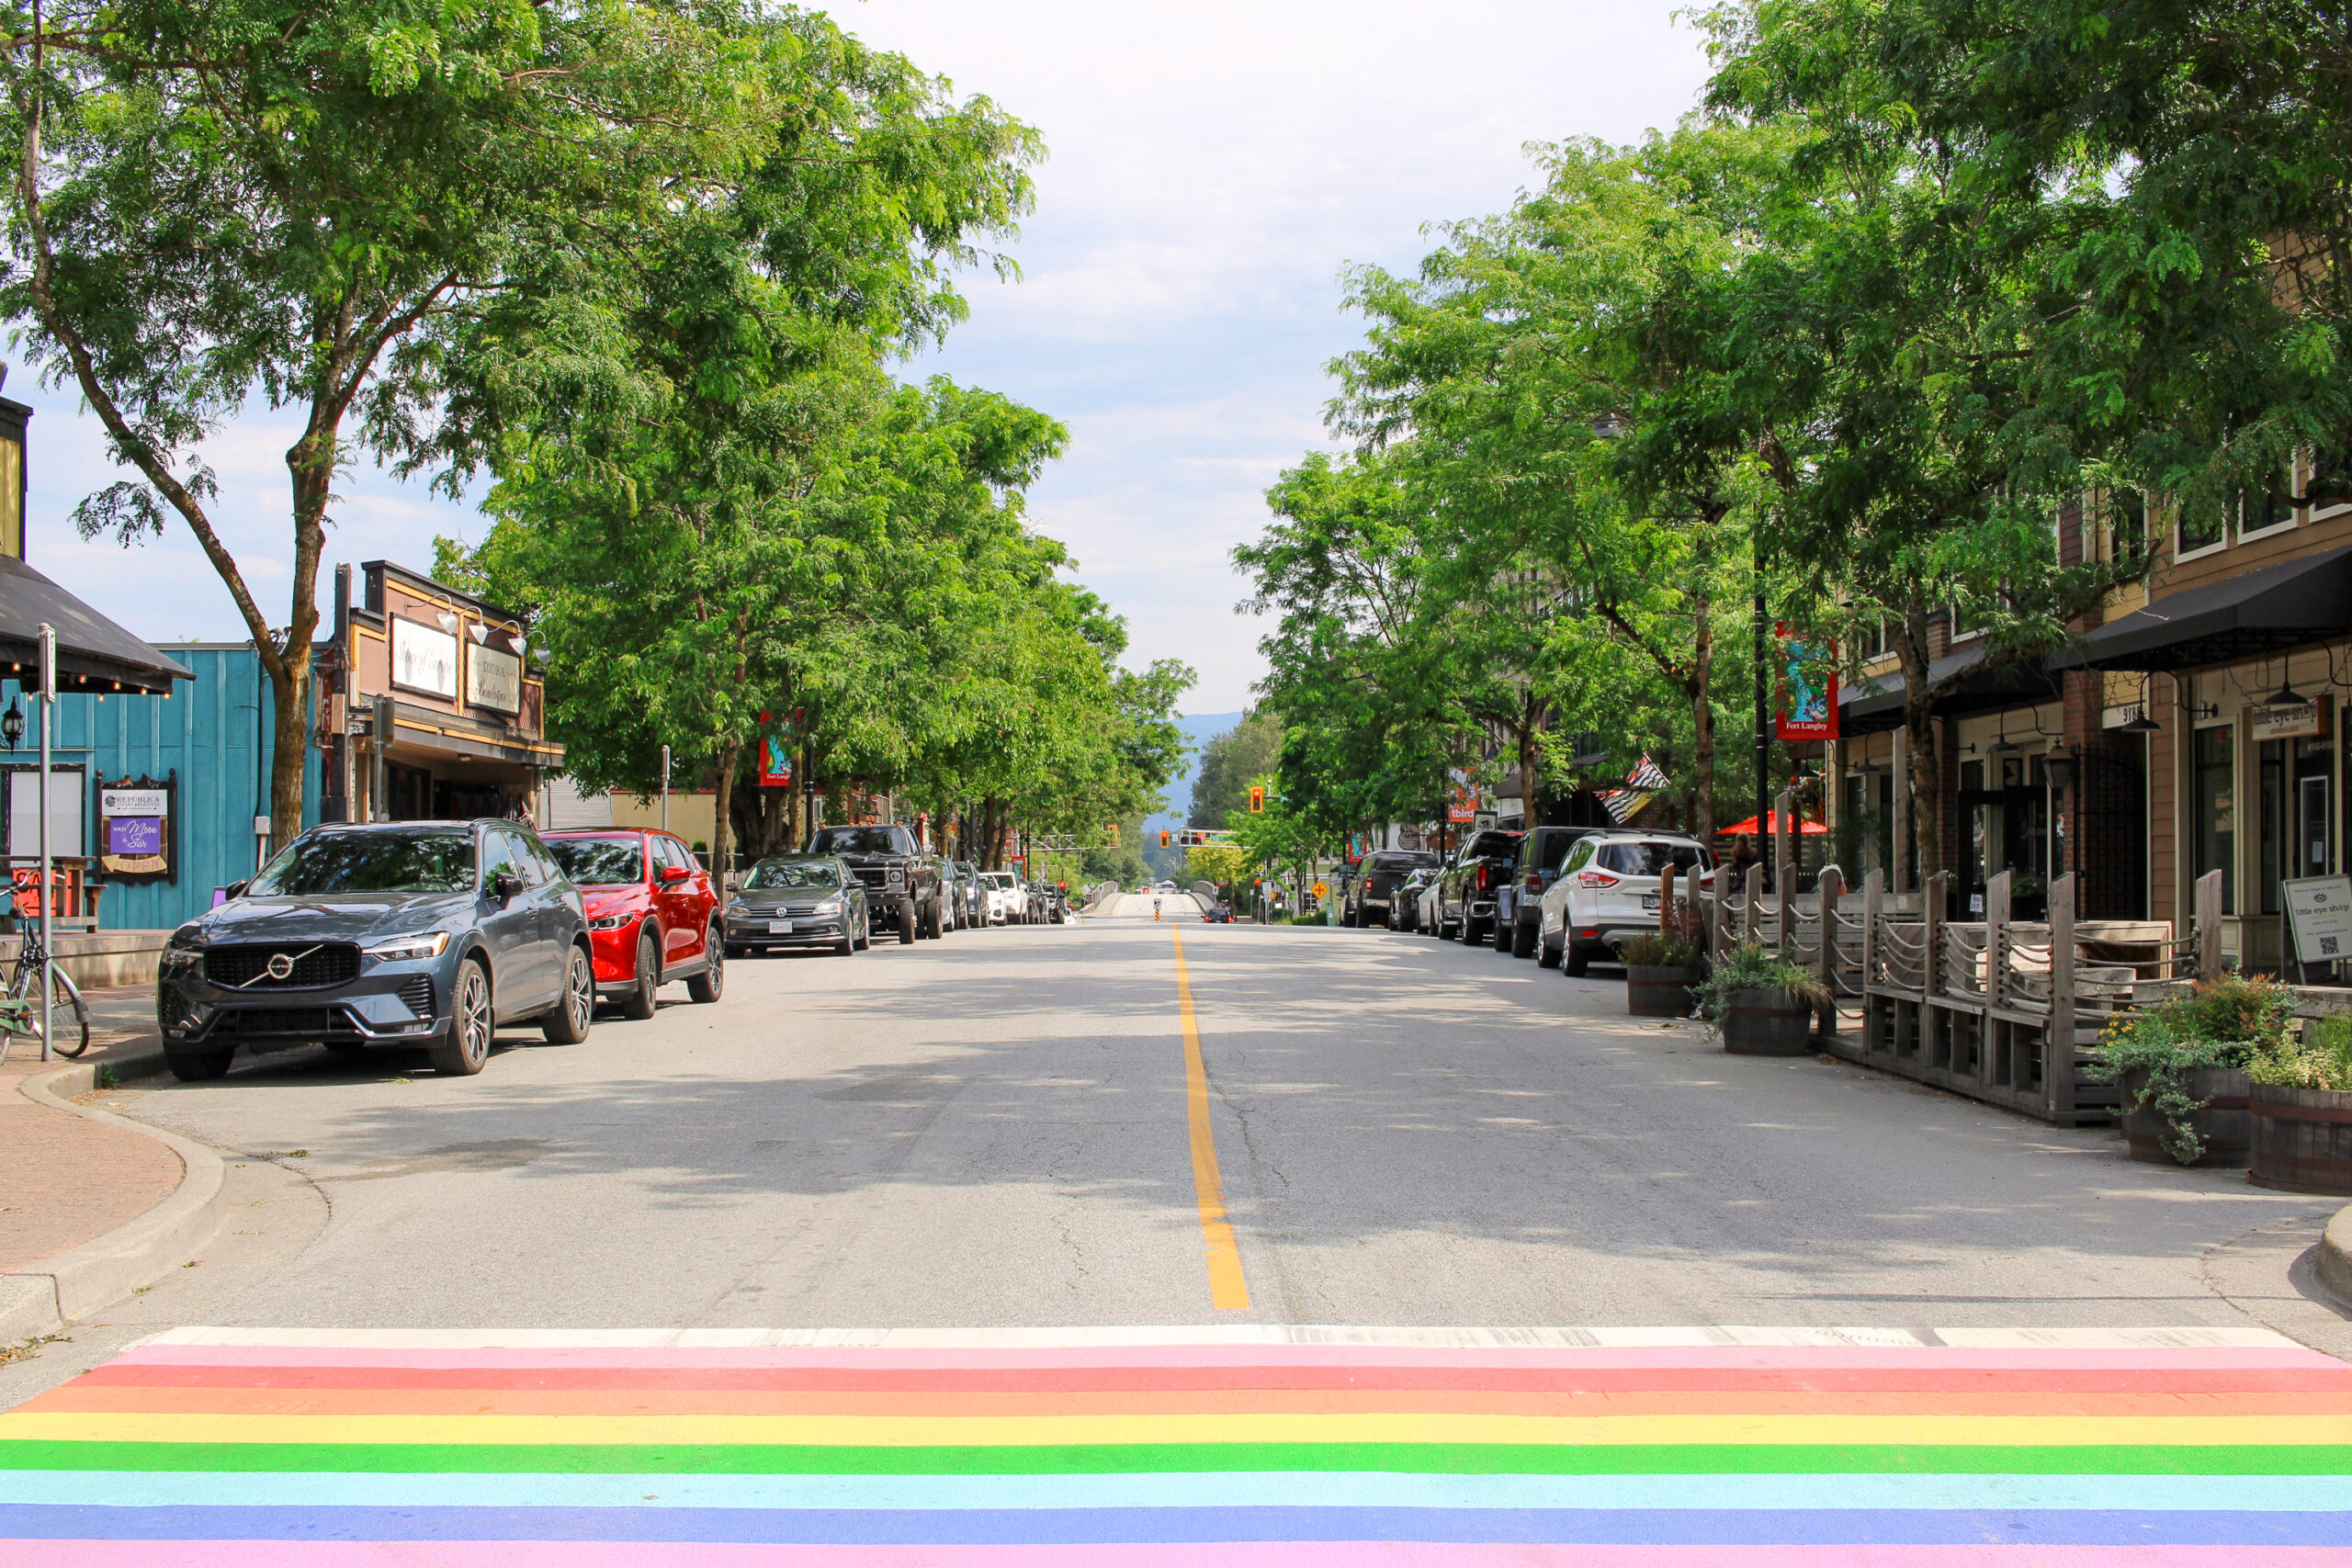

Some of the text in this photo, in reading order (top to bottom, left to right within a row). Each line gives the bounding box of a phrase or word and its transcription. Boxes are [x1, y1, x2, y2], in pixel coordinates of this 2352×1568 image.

[2274, 712, 2290, 727] eye
[1801, 722, 1828, 731] Langley
[1452, 809, 1474, 818] tbird
[127, 820, 157, 835] Moon
[127, 833, 147, 849] Star
[120, 859, 160, 872] OPEN
[2295, 908, 2312, 916] little
[2313, 907, 2327, 915] eye
